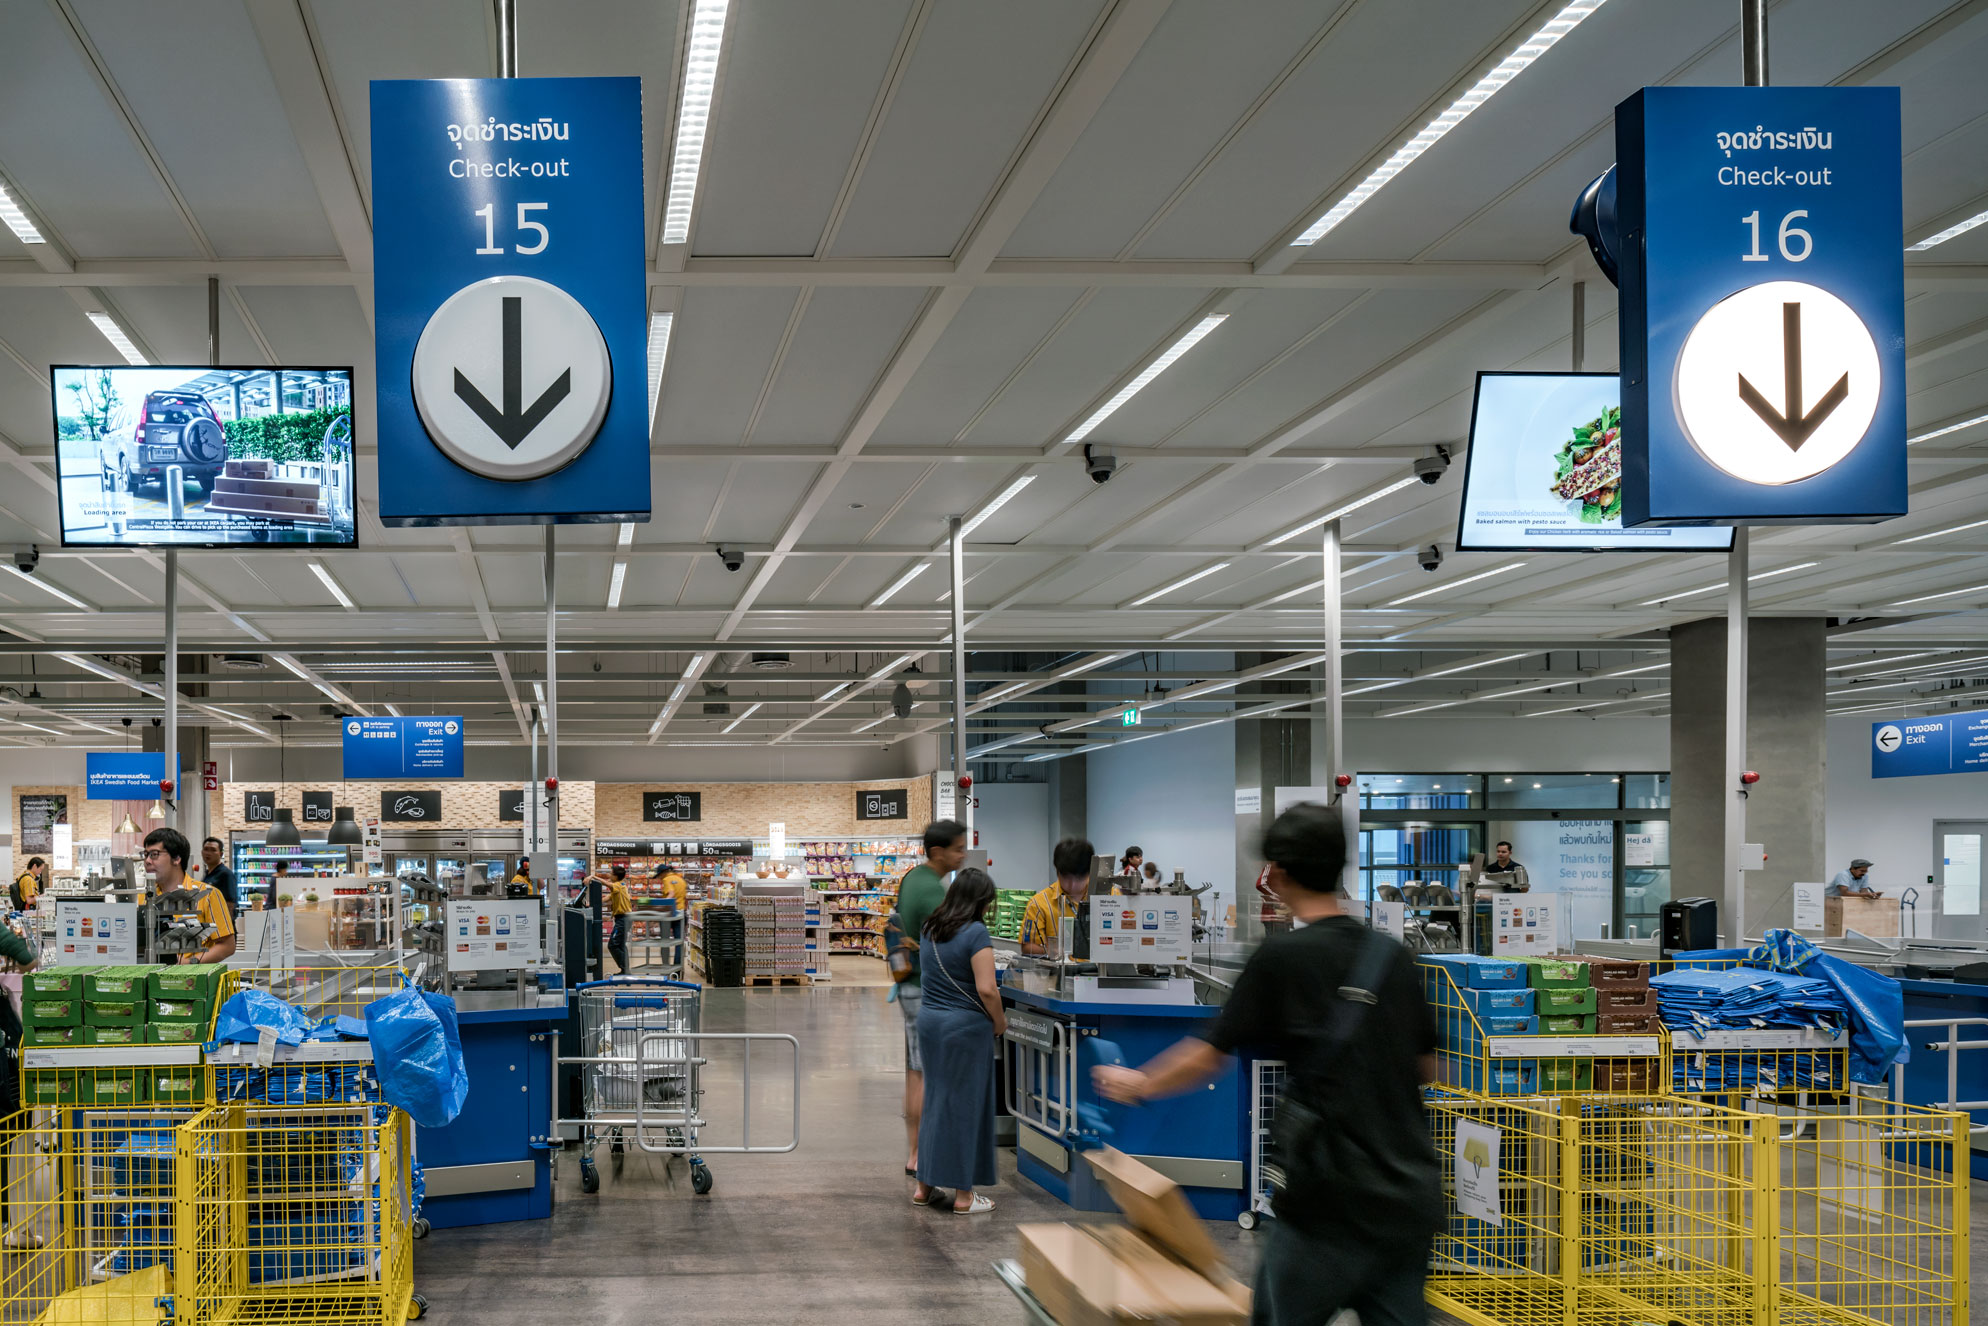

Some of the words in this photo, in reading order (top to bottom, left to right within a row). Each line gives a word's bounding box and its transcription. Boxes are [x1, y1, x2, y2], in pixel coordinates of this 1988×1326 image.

[447, 117, 569, 150] จุดชำระเงิน
[1716, 125, 1832, 158] จุดชำระเงิน
[449, 158, 569, 178] Check-out
[1718, 166, 1832, 186] Check-out
[475, 202, 549, 255] 15
[1742, 209, 1813, 262] 16
[1905, 723, 1943, 734] ทางออก
[1906, 735, 1926, 744] Exit
[1560, 830, 1612, 844] แล้วพบกันใหม่
[703, 847, 714, 855] 50
[1560, 854, 1594, 864] Thanks
[1598, 854, 1612, 864] for
[1560, 869, 1577, 878] See
[1580, 870, 1598, 880] you
